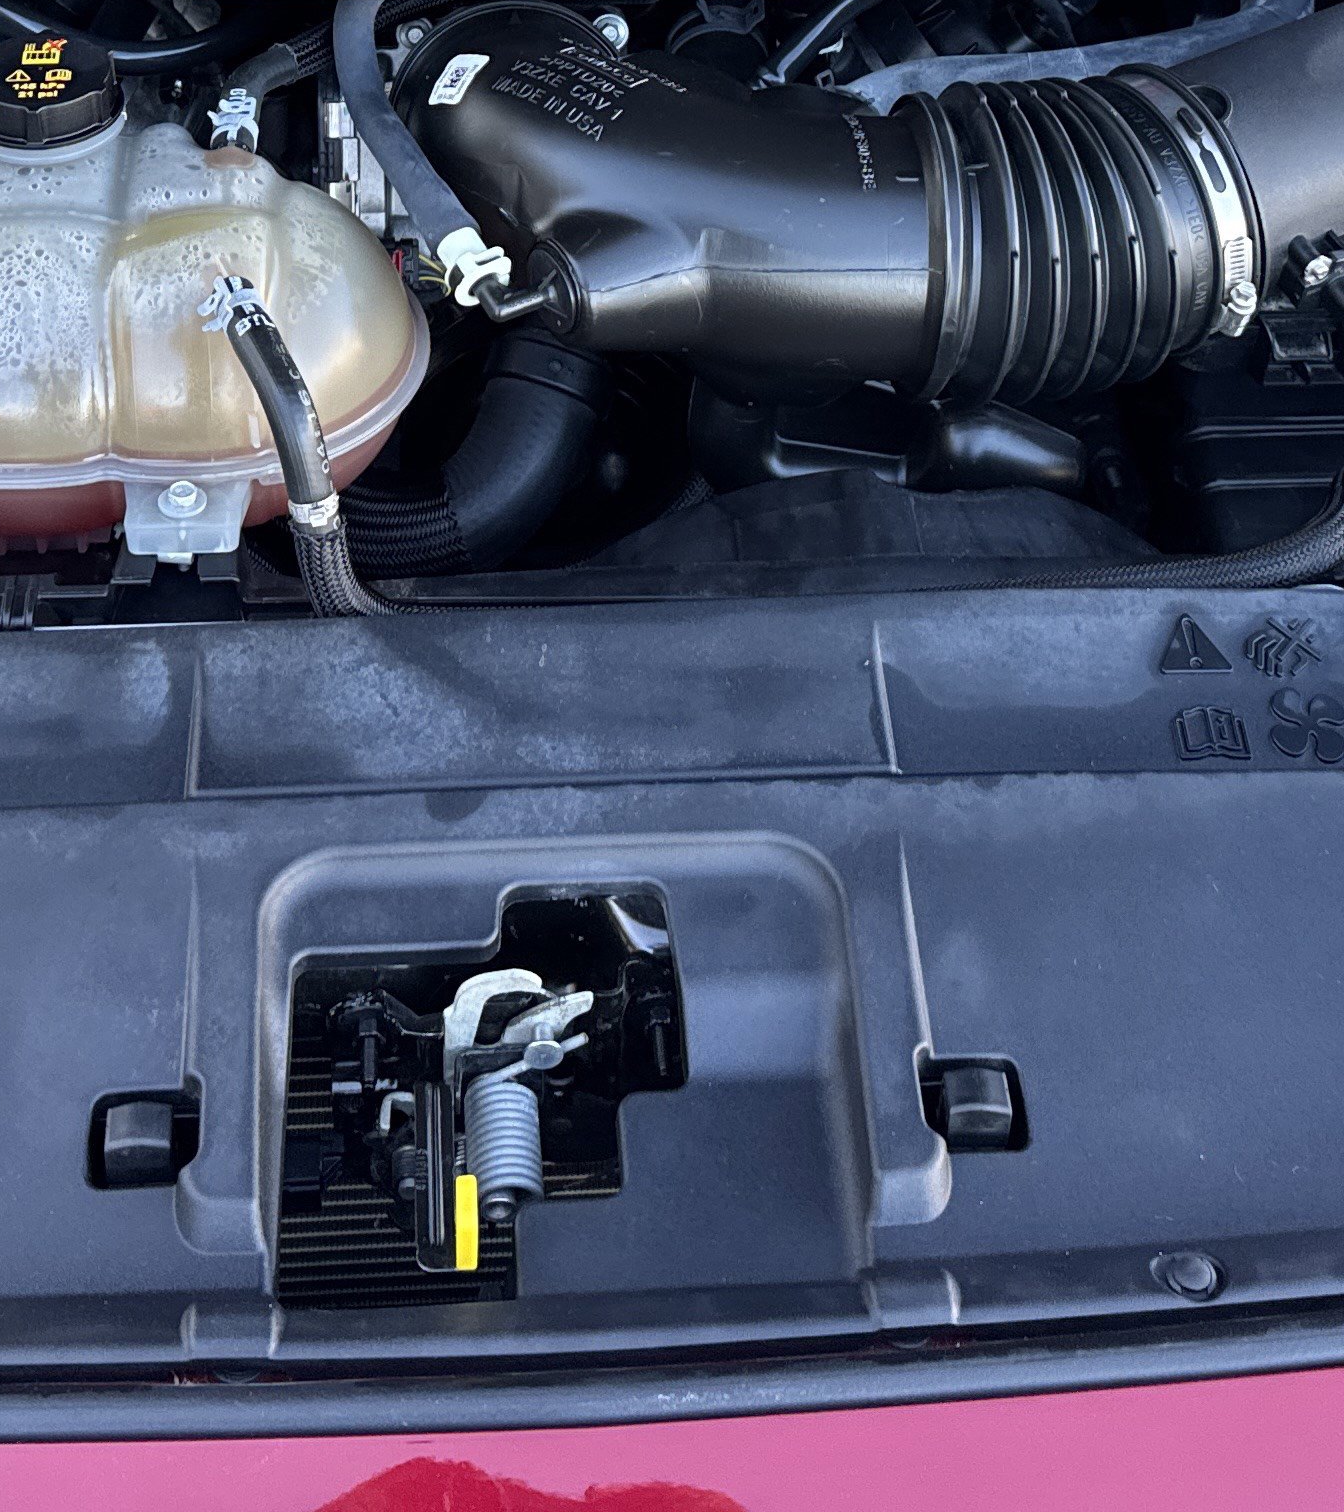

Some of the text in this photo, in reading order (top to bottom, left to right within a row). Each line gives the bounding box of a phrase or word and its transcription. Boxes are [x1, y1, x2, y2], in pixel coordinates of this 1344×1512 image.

[490, 75, 547, 104] MADE
[543, 96, 568, 116] IN
[565, 107, 605, 142] USA
[569, 84, 612, 111] CAV
